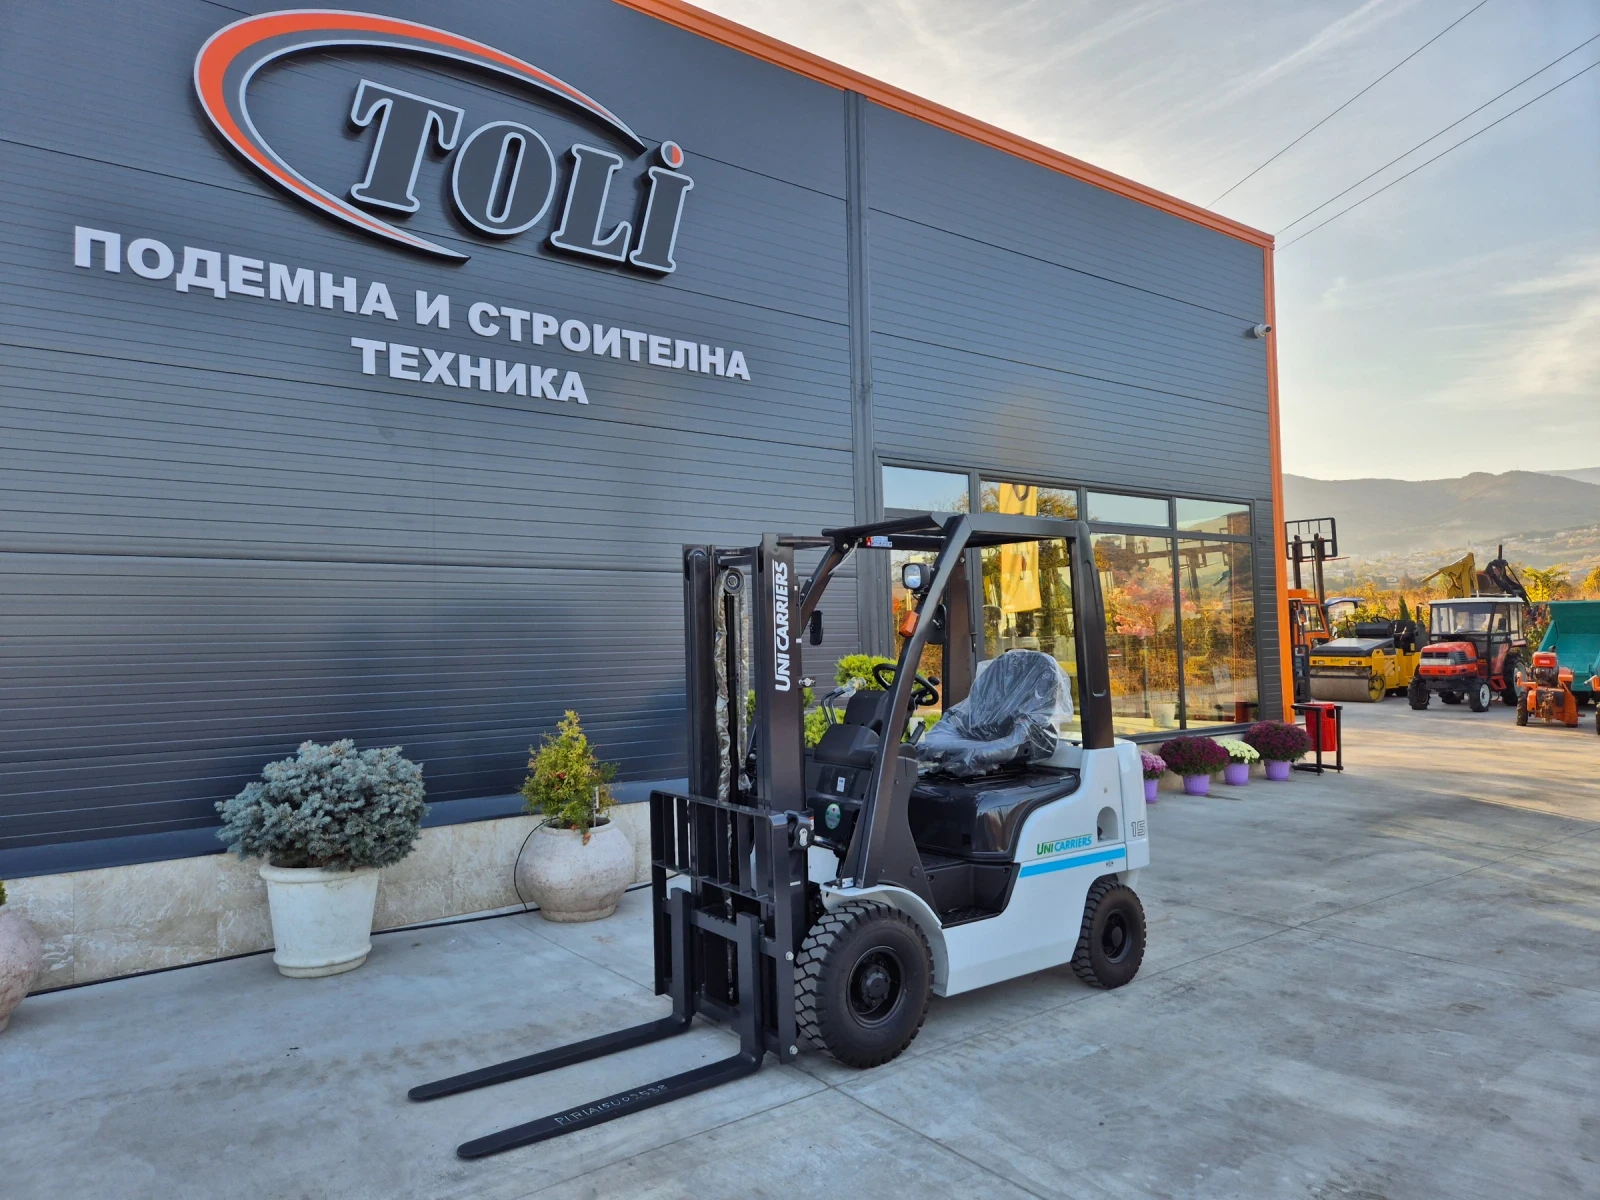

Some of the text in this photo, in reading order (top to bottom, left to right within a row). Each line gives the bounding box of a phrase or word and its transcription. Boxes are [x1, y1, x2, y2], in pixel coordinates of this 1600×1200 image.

[74, 226, 751, 381] ПОДЕМНА И СТРОИТЕЛНА
[351, 337, 589, 404] ТЕХНИКА
[1130, 820, 1145, 837] 15
